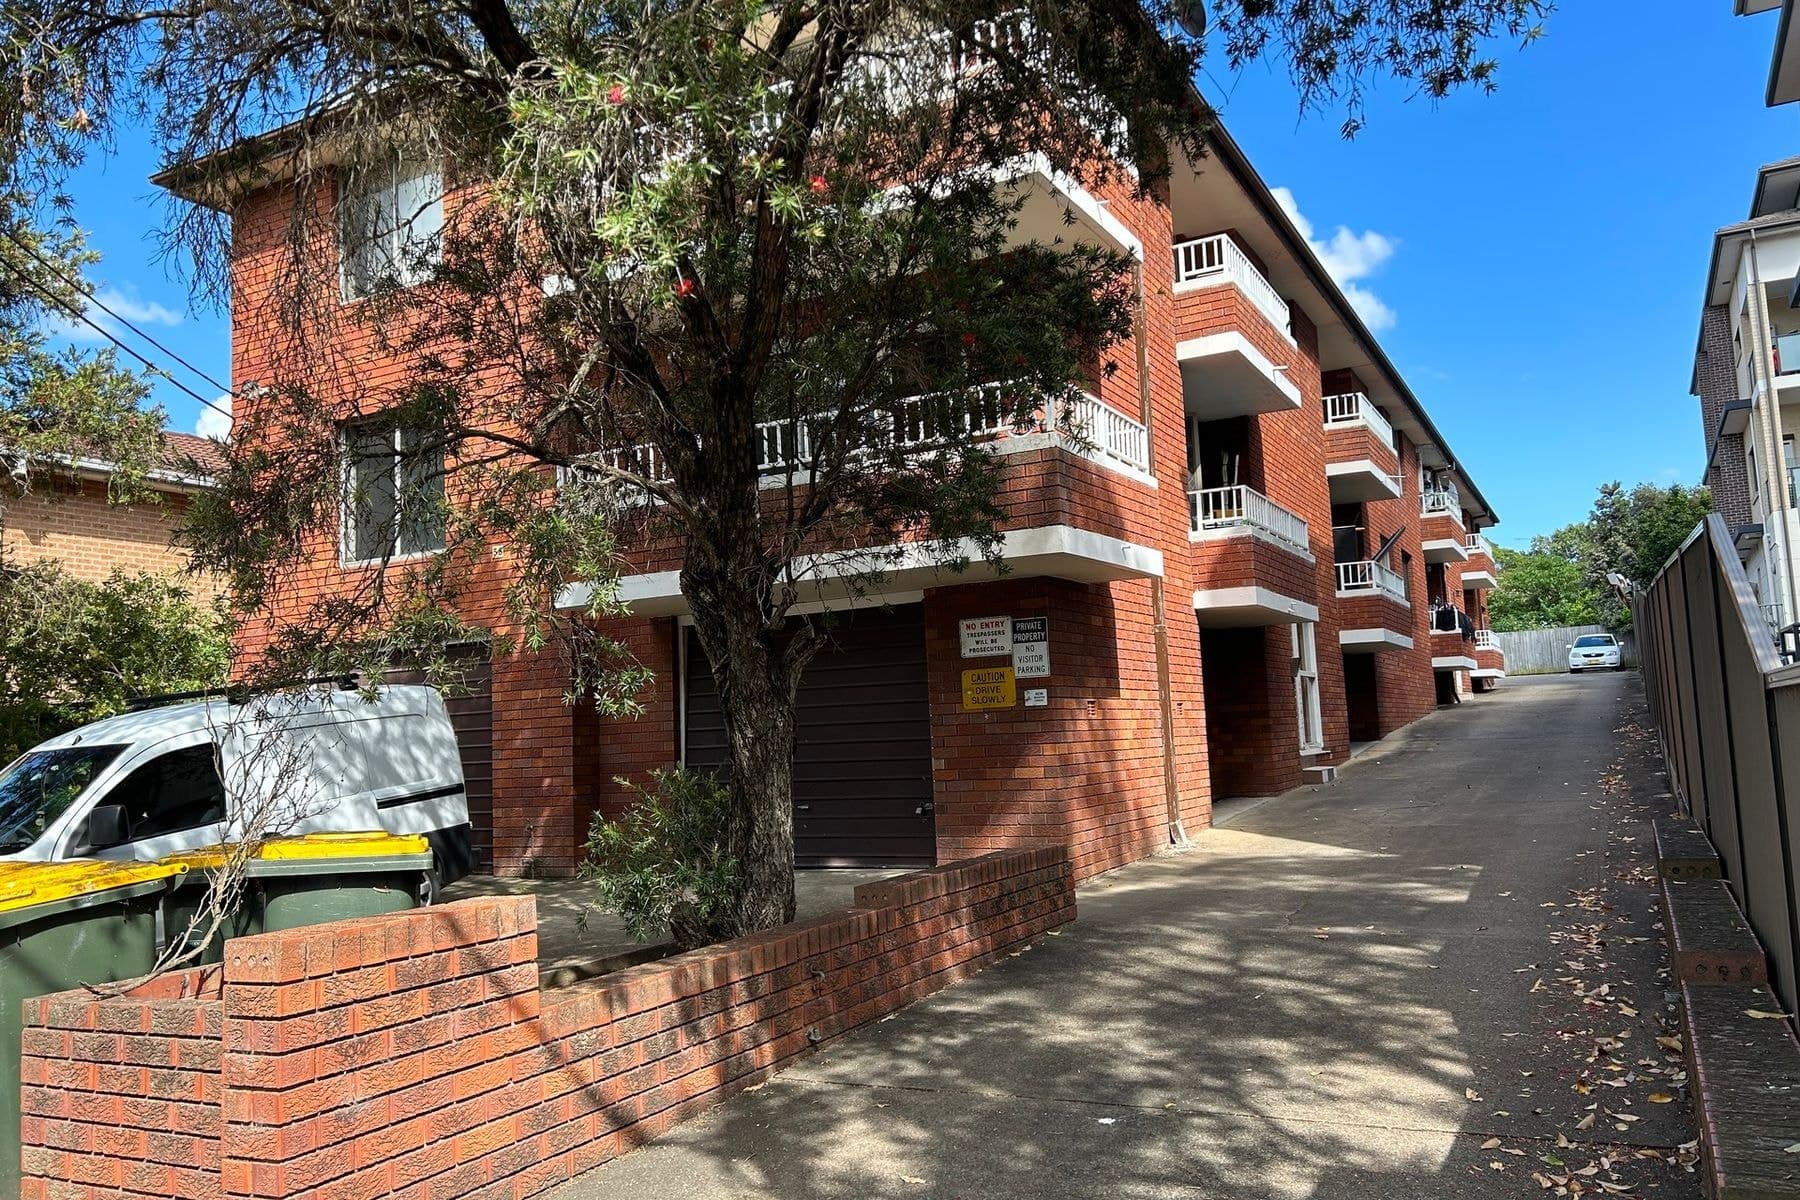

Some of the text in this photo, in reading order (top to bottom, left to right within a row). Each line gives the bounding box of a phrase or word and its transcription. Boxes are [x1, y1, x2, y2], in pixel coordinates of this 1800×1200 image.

[965, 620, 1005, 631] NO ENTRY
[1016, 621, 1042, 630] PRIVATE
[1013, 632, 1045, 641] PROPERTY
[1025, 645, 1035, 653] NO
[1018, 655, 1043, 663] VISITOR
[1017, 665, 1045, 674] PARKING
[971, 671, 1004, 682] CAUTION
[976, 686, 1001, 694] DRIVE
[972, 695, 1005, 704] SLOWLY
